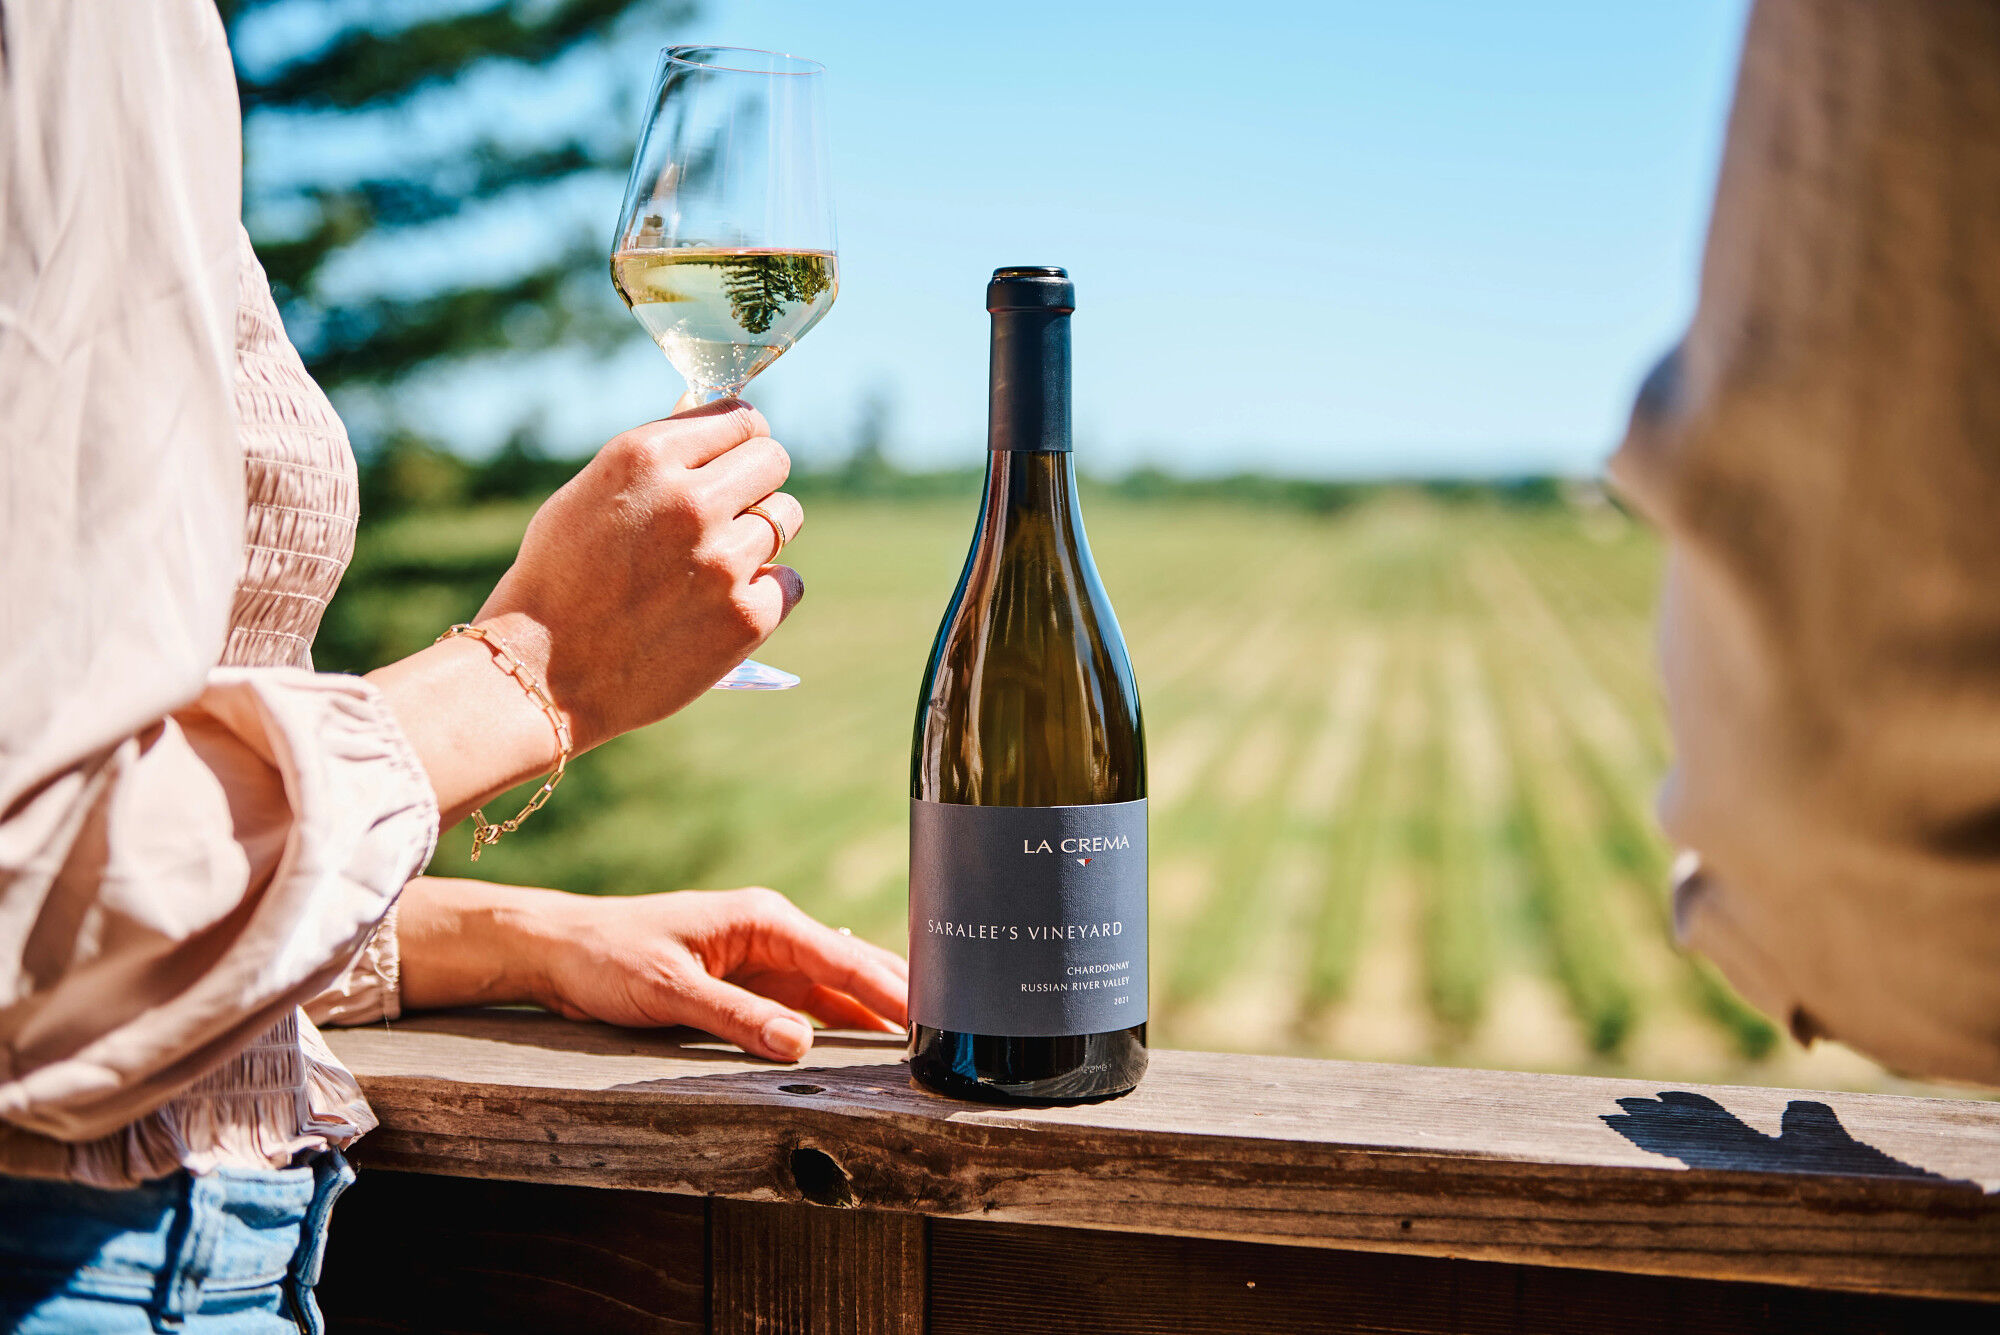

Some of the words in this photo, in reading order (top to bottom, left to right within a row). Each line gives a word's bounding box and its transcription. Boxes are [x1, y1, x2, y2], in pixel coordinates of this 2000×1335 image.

[1023, 839, 1053, 854] LA
[1060, 835, 1130, 853] CREMA
[928, 919, 1018, 940] SARALEE'S
[1028, 921, 1123, 940] VINEYARD
[1067, 961, 1130, 976] CHARDONNAY
[1021, 982, 1068, 992] RUSSIAN
[1072, 981, 1100, 992] RIVER
[1102, 976, 1130, 989] VALLEY
